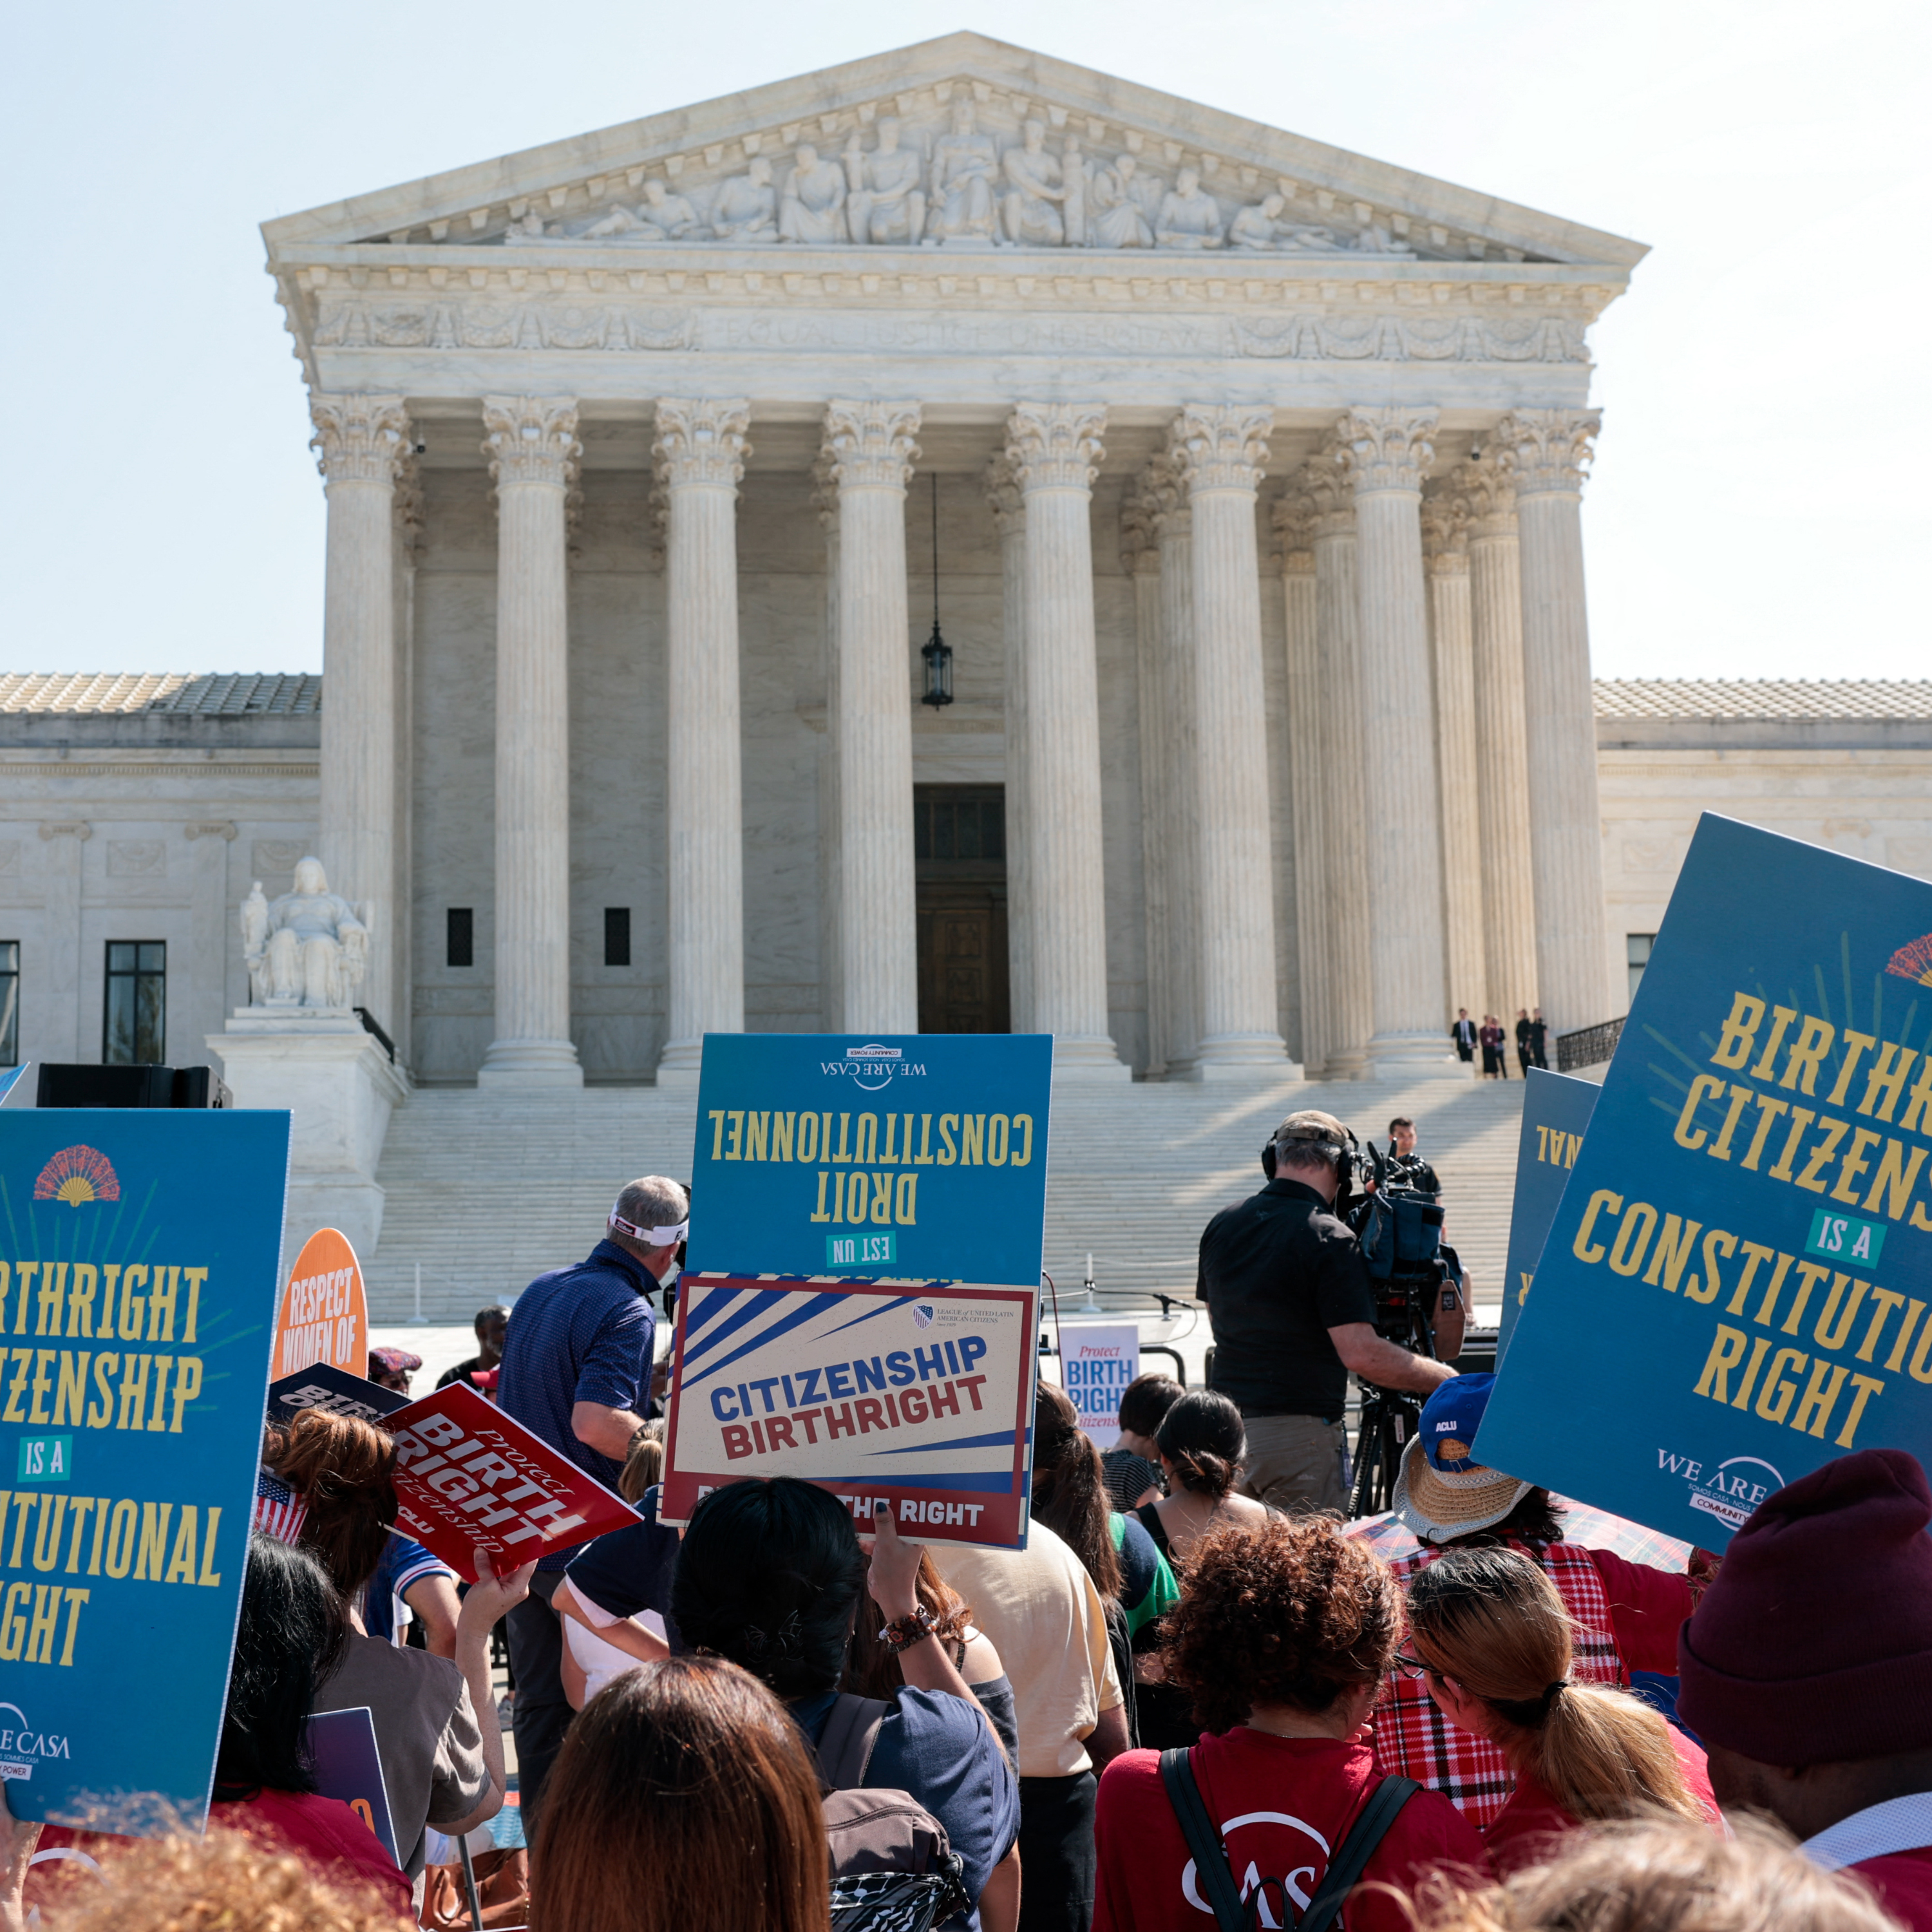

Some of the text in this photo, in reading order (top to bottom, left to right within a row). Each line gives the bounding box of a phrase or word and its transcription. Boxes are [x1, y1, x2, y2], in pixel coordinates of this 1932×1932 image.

[726, 318, 842, 345] EQUAL
[820, 1063, 927, 1075] WE ARE CASA
[708, 1110, 1033, 1166] CONSTITUTIONNEL
[810, 1171, 918, 1225] DROIT
[833, 1236, 890, 1264] EST UN
[1817, 1215, 1871, 1260] IS A
[289, 1267, 354, 1327] RESPECT
[282, 1315, 356, 1374] WOMEN OF
[1079, 1346, 1121, 1358] Protect
[710, 1336, 987, 1422] CITIZENSHIP
[1067, 1359, 1133, 1385] BIRTH
[1692, 1323, 1884, 1448] RIGHT
[294, 1385, 386, 1419] BIR
[721, 1374, 987, 1460] BIRTHRIGHT
[1435, 1421, 1457, 1432] ACLU
[25, 1441, 63, 1474] IS A
[409, 1412, 587, 1535] BIRTH
[472, 1428, 575, 1495] Protect
[1658, 1448, 1767, 1506] WE ARE
[395, 1429, 554, 1545] RIGHT
[1687, 1483, 1712, 1497] SOMOS
[1712, 1492, 1729, 1503] CASA
[1732, 1500, 1751, 1512] NOUS
[391, 1466, 504, 1553] tizenship
[397, 1502, 436, 1534] CLU
[900, 1499, 984, 1527] RIGHT
[1697, 1499, 1748, 1524] COMMUNITY
[0, 1580, 91, 1667] GHT
[3, 1754, 25, 1763] SOMMES
[16, 1731, 71, 1759] CASA
[3, 1765, 26, 1776] POWER
[1182, 1861, 1345, 1929] CAS
